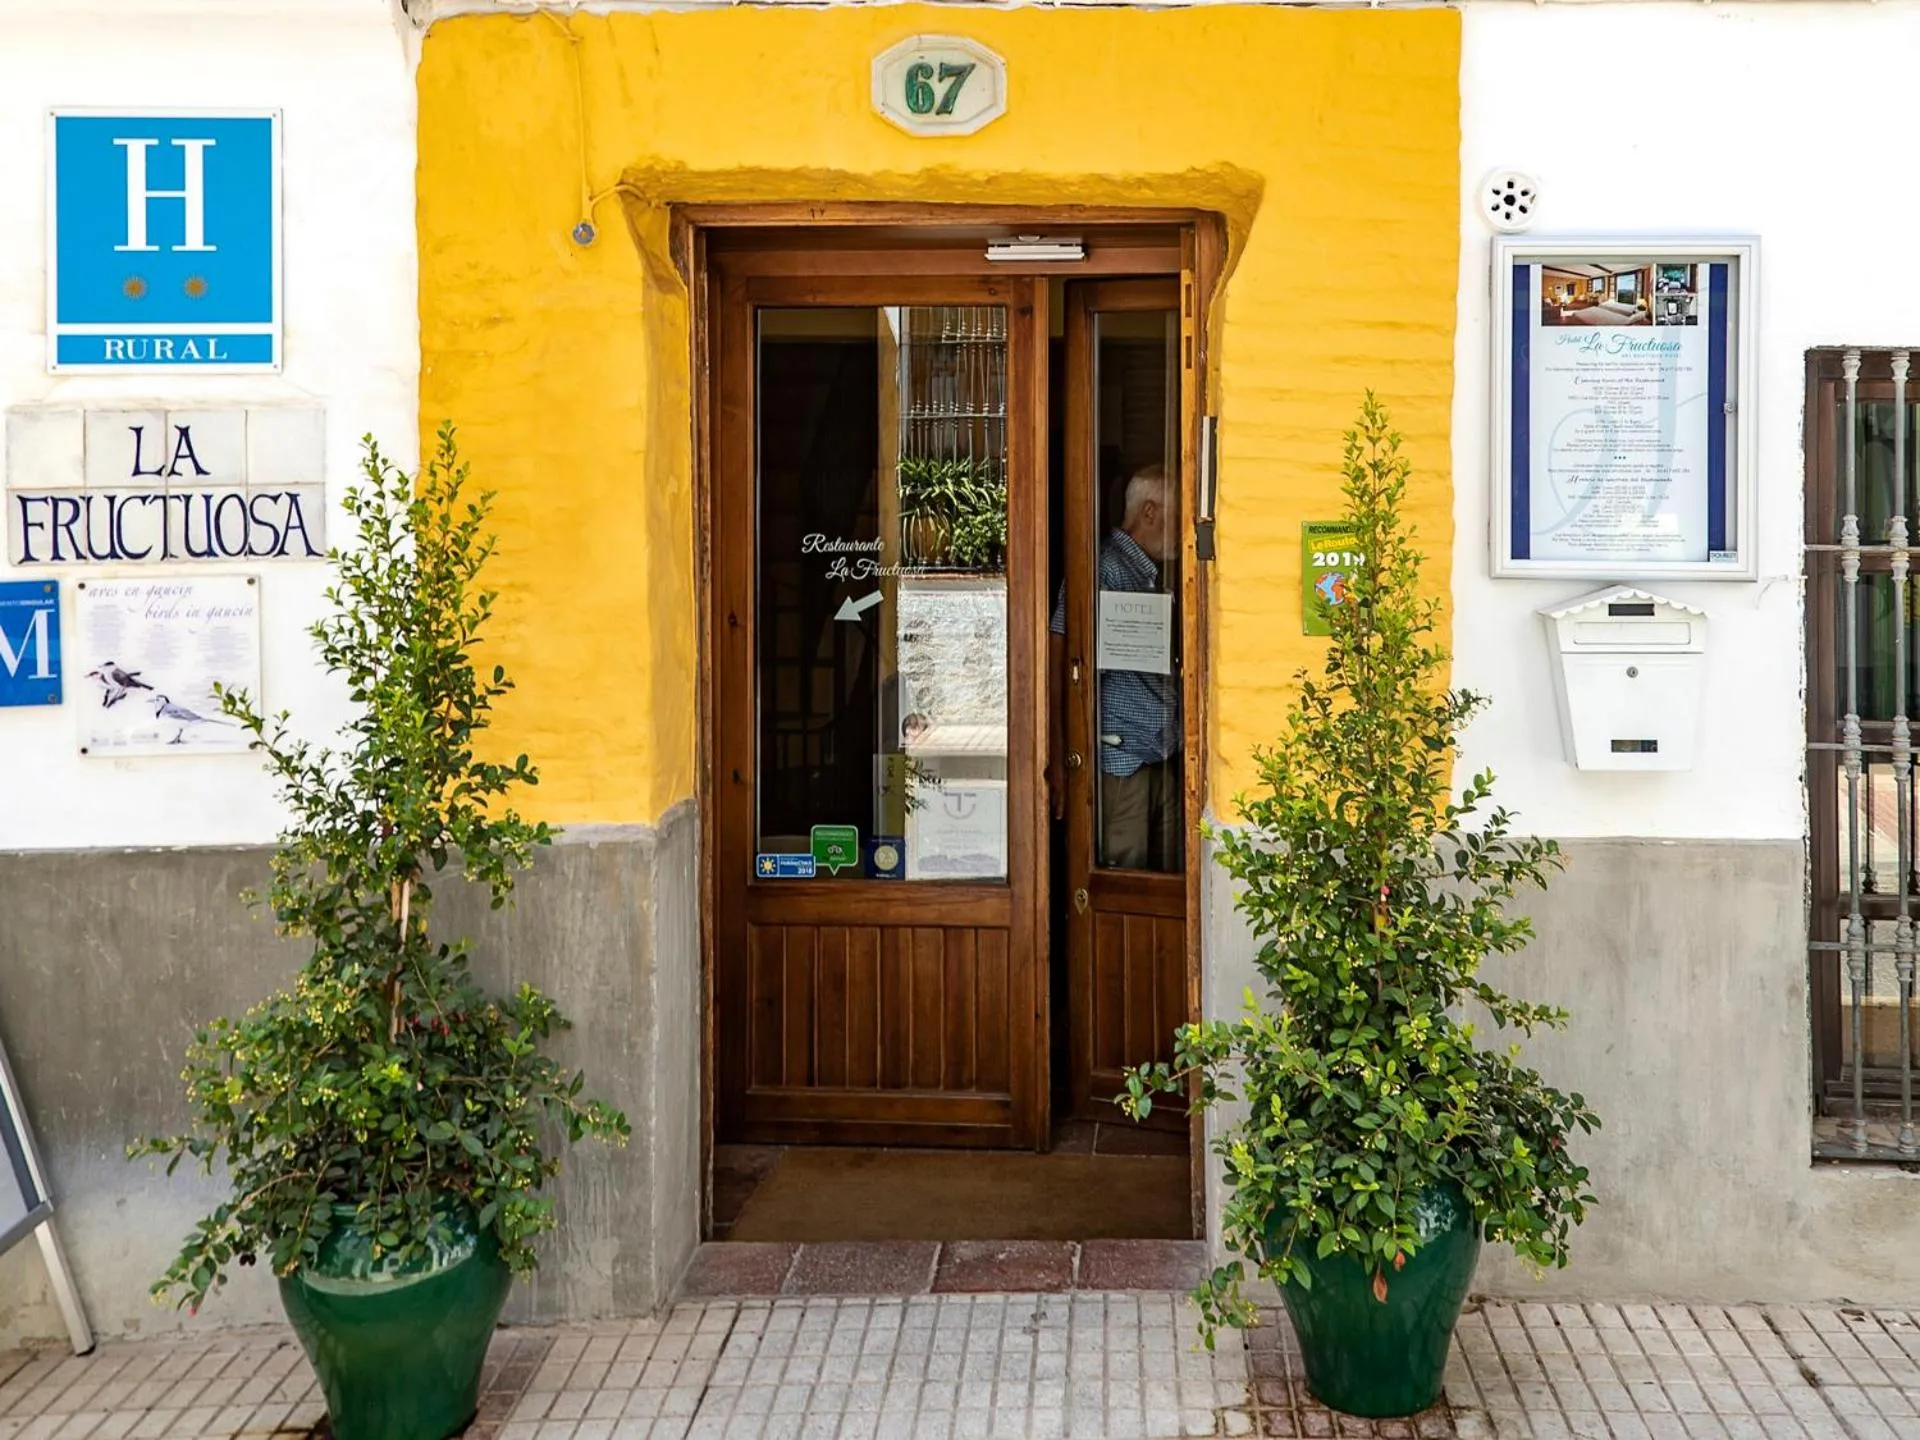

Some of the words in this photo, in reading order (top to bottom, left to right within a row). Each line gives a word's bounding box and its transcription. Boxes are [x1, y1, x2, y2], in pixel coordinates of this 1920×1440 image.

[904, 62, 977, 116] 67
[112, 137, 217, 252] H
[104, 338, 228, 360] RURAL
[1580, 331, 1604, 356] La
[1606, 333, 1682, 354] Fructuosa
[129, 424, 211, 478] LA
[17, 490, 324, 566] FRUCTUOSA
[801, 533, 885, 554] Restaurante
[825, 556, 849, 582] La
[850, 558, 925, 580] Fructuosa
[145, 600, 180, 620] birds
[186, 603, 200, 618] in
[1113, 602, 1157, 616] HOTEL
